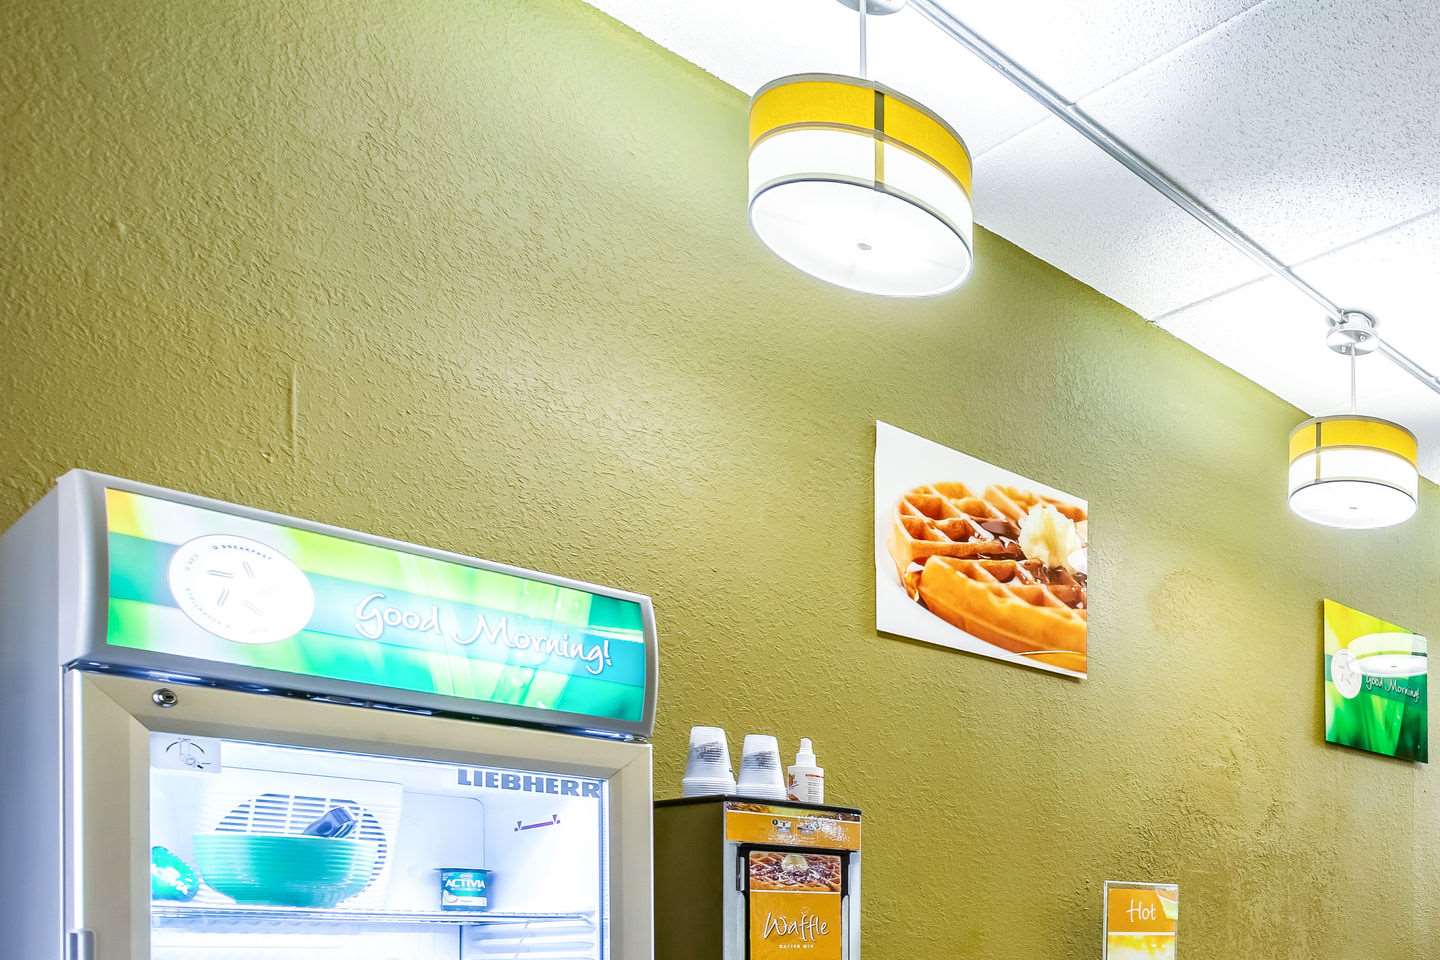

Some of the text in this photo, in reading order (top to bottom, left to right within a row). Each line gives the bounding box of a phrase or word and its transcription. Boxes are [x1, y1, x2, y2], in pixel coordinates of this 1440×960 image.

[355, 592, 613, 675] Good Morning!
[457, 768, 600, 798] LIEBHERR
[445, 879, 486, 889] ACTIVIA
[1125, 897, 1157, 923] Hot
[762, 911, 831, 942] Waffle
